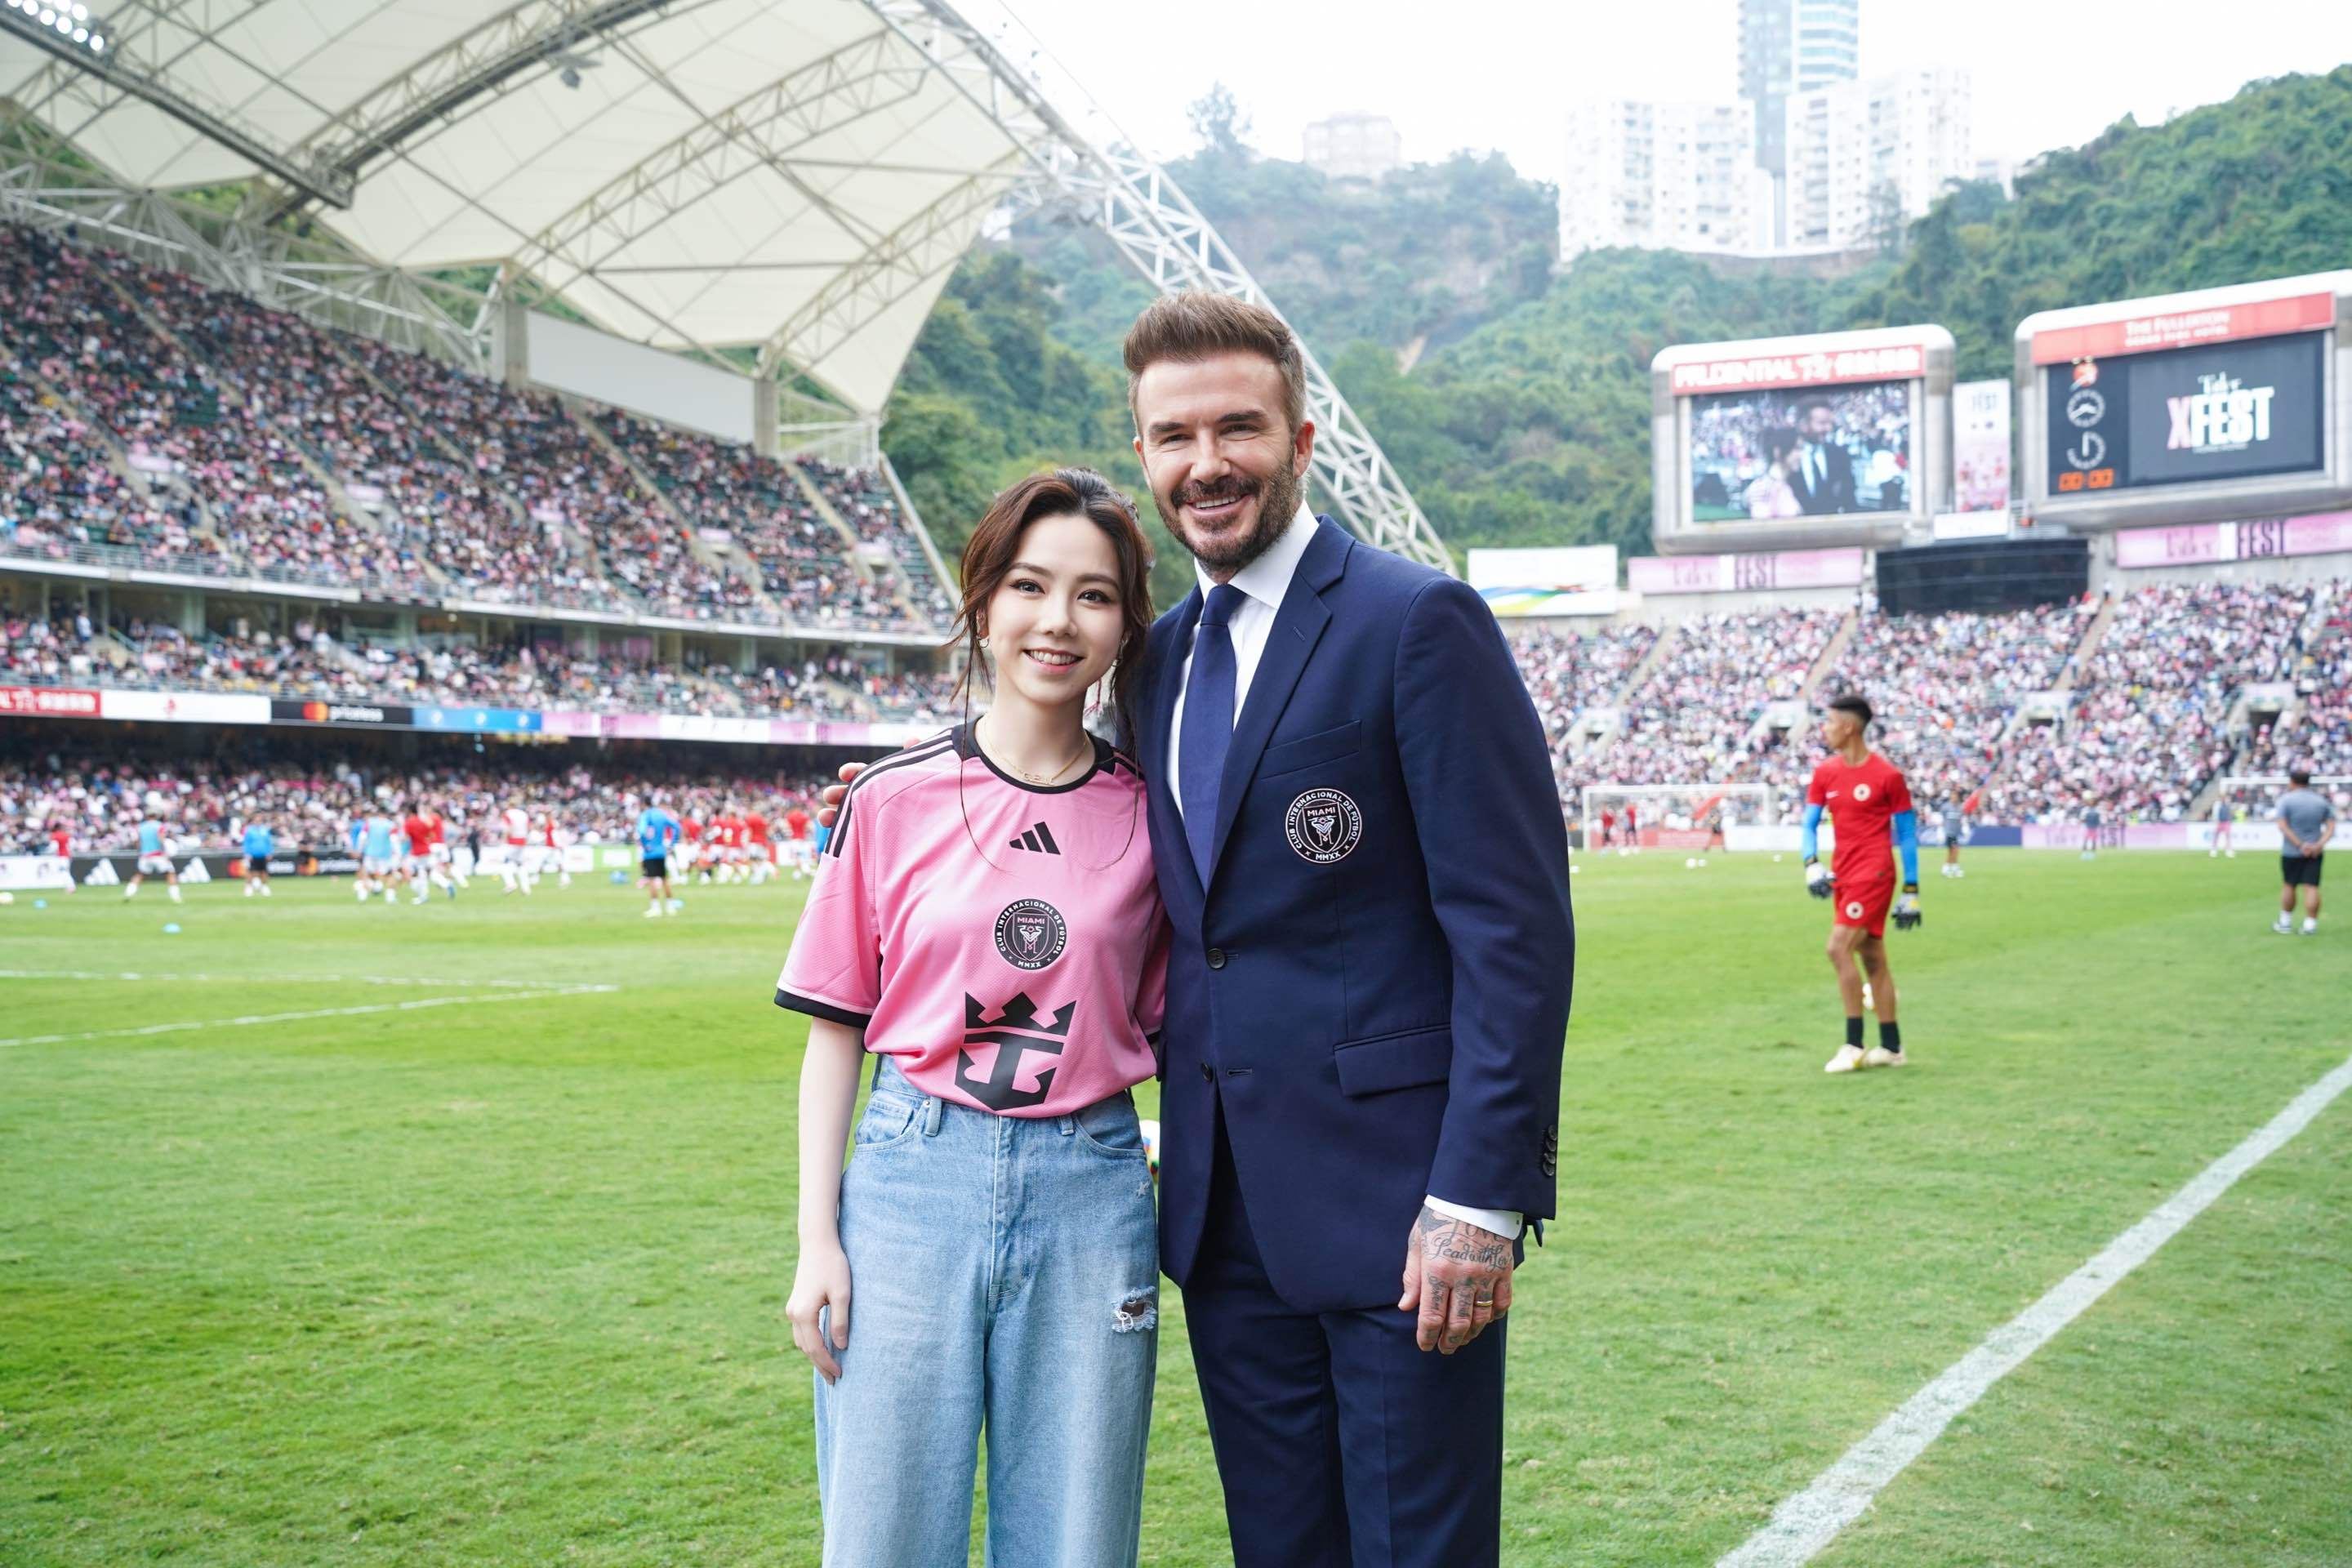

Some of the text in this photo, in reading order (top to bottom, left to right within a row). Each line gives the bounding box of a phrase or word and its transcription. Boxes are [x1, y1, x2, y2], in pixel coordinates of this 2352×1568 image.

[1289, 792, 1343, 826] INTERNACIONAL
[1343, 800, 1352, 811] DE
[1307, 807, 1336, 817] MIAMI
[1290, 828, 1302, 849] CLUB
[1316, 851, 1341, 861] MMXX
[997, 901, 1054, 929] INTERNACIONAL
[1018, 916, 1045, 924] MIAMI
[1054, 915, 1062, 924] DE
[996, 931, 1006, 951] CLUB
